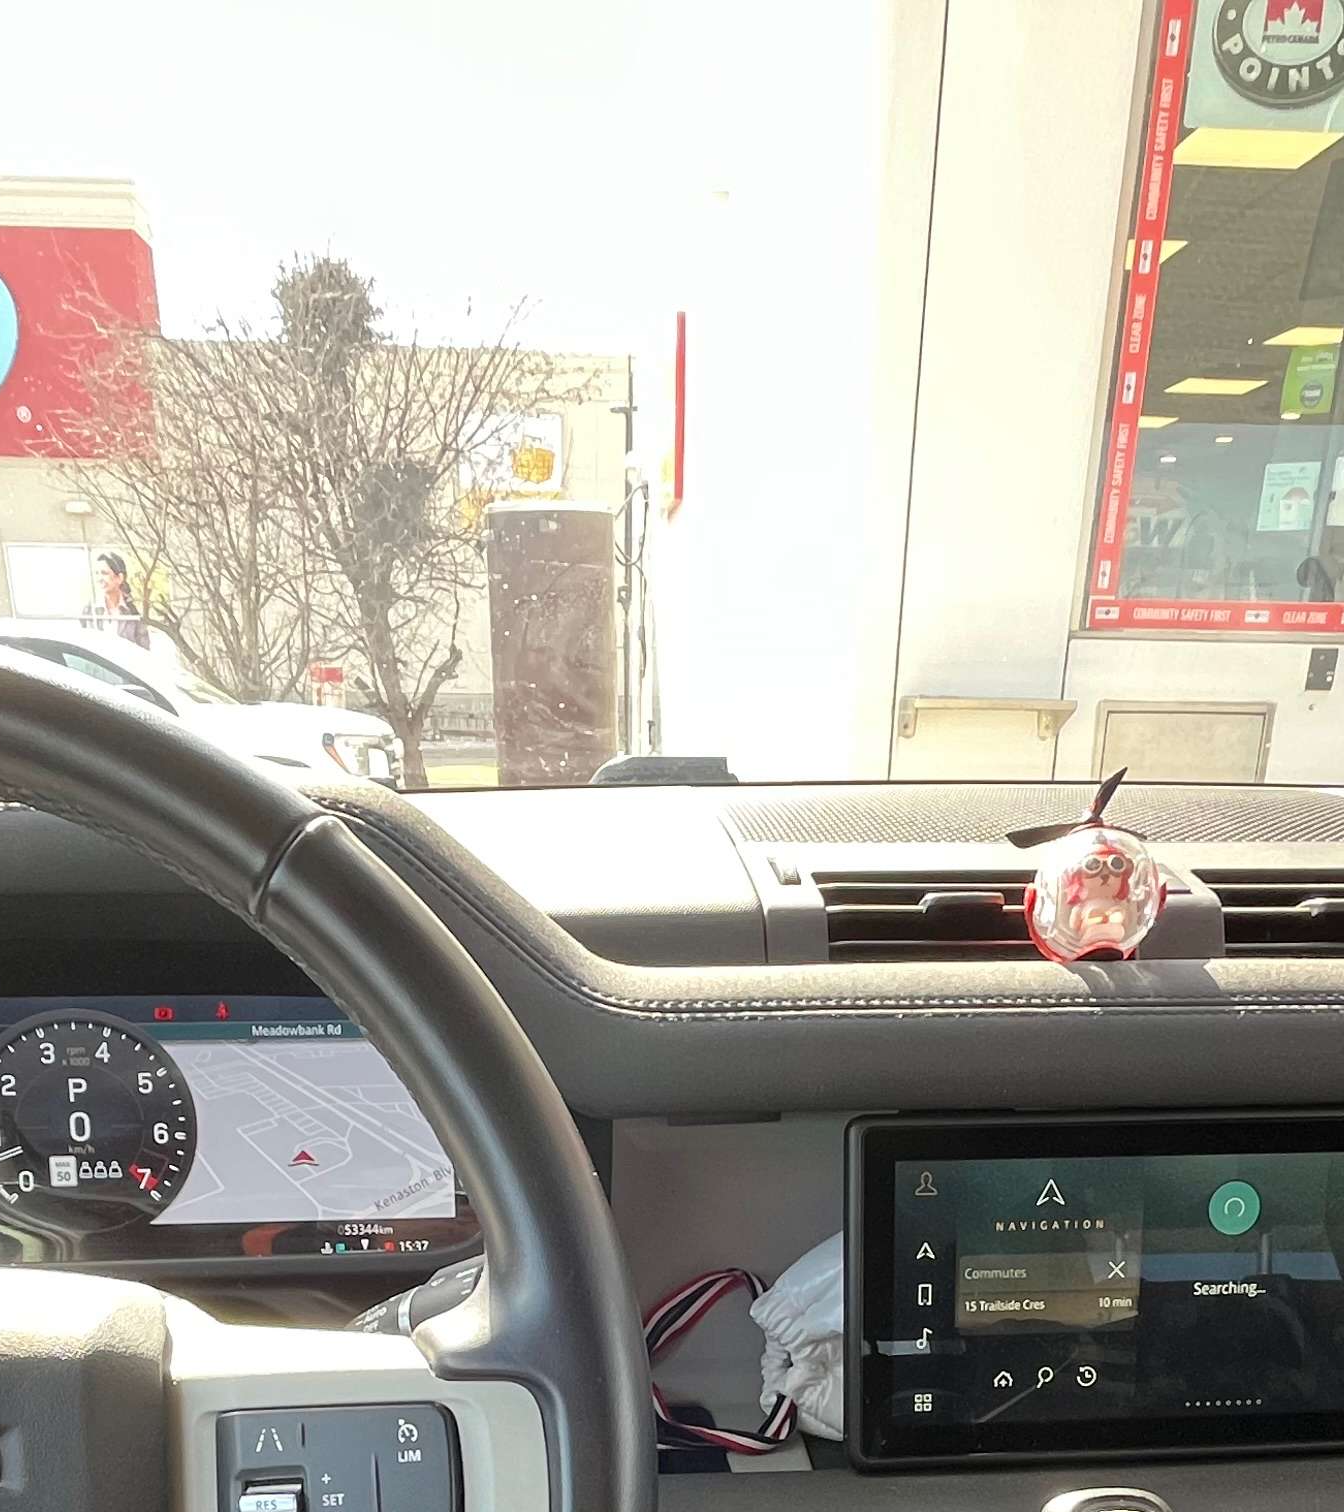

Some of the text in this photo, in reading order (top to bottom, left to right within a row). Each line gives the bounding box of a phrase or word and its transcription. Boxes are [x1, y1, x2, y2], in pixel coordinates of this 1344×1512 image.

[1116, 423, 1130, 449] FIRST
[1111, 451, 1126, 486] SAFETY
[1133, 607, 1231, 623] COMMUNITY SAFETY FIRST
[1282, 611, 1328, 625] CLEAR ZONE
[251, 1024, 342, 1037] Meadowbank Rd
[39, 1042, 56, 1064] 3
[95, 1041, 111, 1063] 4
[0, 1074, 17, 1096] 2
[68, 1078, 87, 1102] P
[137, 1072, 153, 1094] 5
[69, 1111, 91, 1142] 0
[152, 1122, 169, 1144] 6
[68, 1144, 95, 1154] km/h
[18, 1170, 35, 1192] 0
[56, 1172, 71, 1182] 50
[137, 1167, 152, 1189] 7
[374, 1177, 430, 1212] Kenaston
[995, 1219, 1105, 1232] NAVIGATION
[964, 1267, 1027, 1280] Commutes
[964, 1299, 1045, 1312] 15 Trailside Cres
[1098, 1297, 1132, 1308] 10 min
[397, 1449, 422, 1463] LIM
[256, 1500, 278, 1512] RES
[321, 1493, 345, 1507] SET
